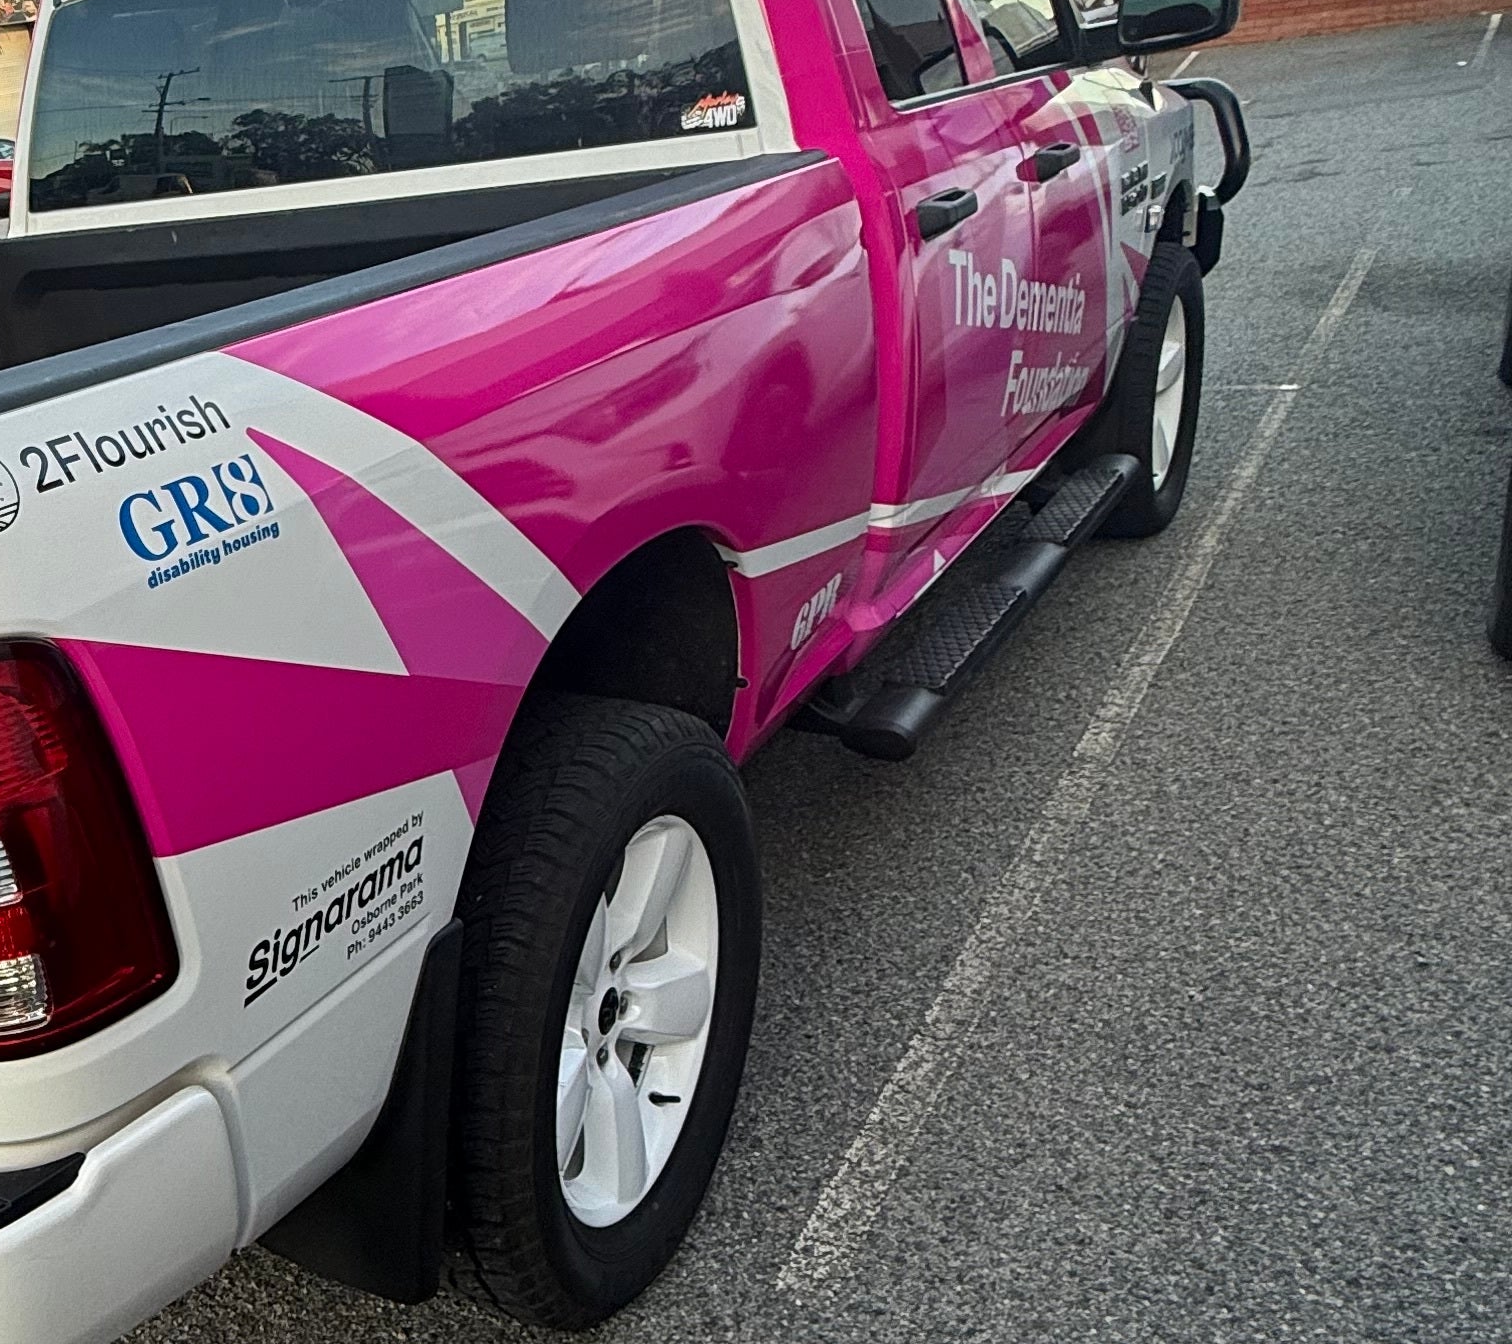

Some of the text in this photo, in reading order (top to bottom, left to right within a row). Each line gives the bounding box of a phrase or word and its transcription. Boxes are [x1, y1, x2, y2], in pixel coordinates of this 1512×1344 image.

[703, 104, 738, 128] 4WD
[949, 248, 1086, 335] The Dementia
[1000, 349, 1089, 417] Foundation
[19, 394, 231, 494] 2Flourish
[119, 453, 275, 561] GR8
[147, 522, 281, 590] disability housing
[292, 810, 424, 912] This vehicle wrapped by
[245, 834, 425, 990] Signarama
[347, 890, 424, 960] Ph: 9443 3663
[351, 872, 424, 935] Osborne Park
